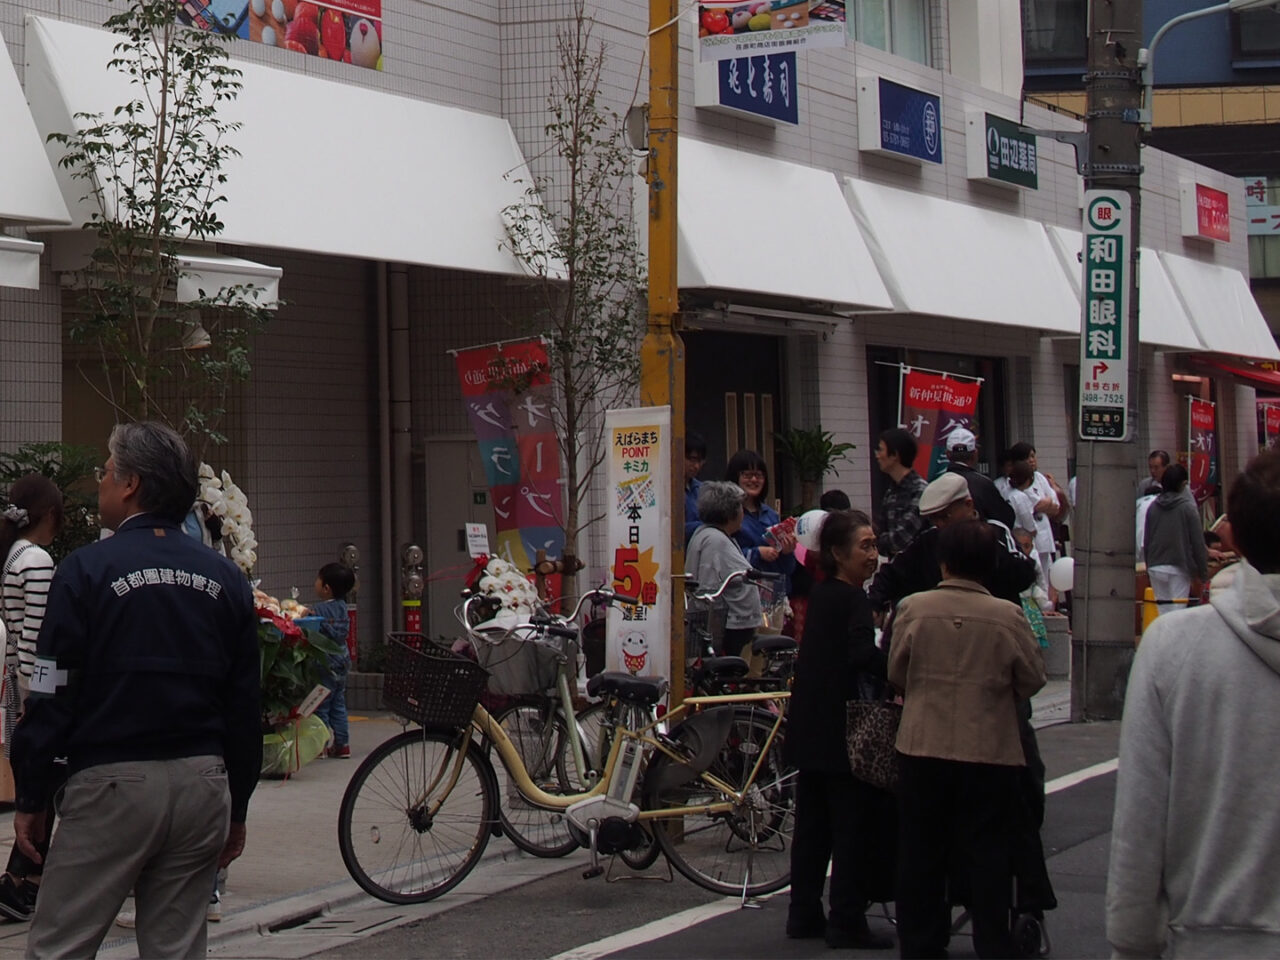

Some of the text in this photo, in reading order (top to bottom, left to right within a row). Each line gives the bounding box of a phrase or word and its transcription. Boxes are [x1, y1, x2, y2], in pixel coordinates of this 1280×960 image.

[1000, 136, 1036, 175] 田辺薬局
[1097, 207, 1112, 221] 眼
[1088, 236, 1117, 358] 和田眼科
[615, 432, 658, 446] えばらまち
[622, 446, 650, 459] POINT
[627, 503, 643, 545] 本日
[110, 567, 222, 600] 首都圏建物管理
